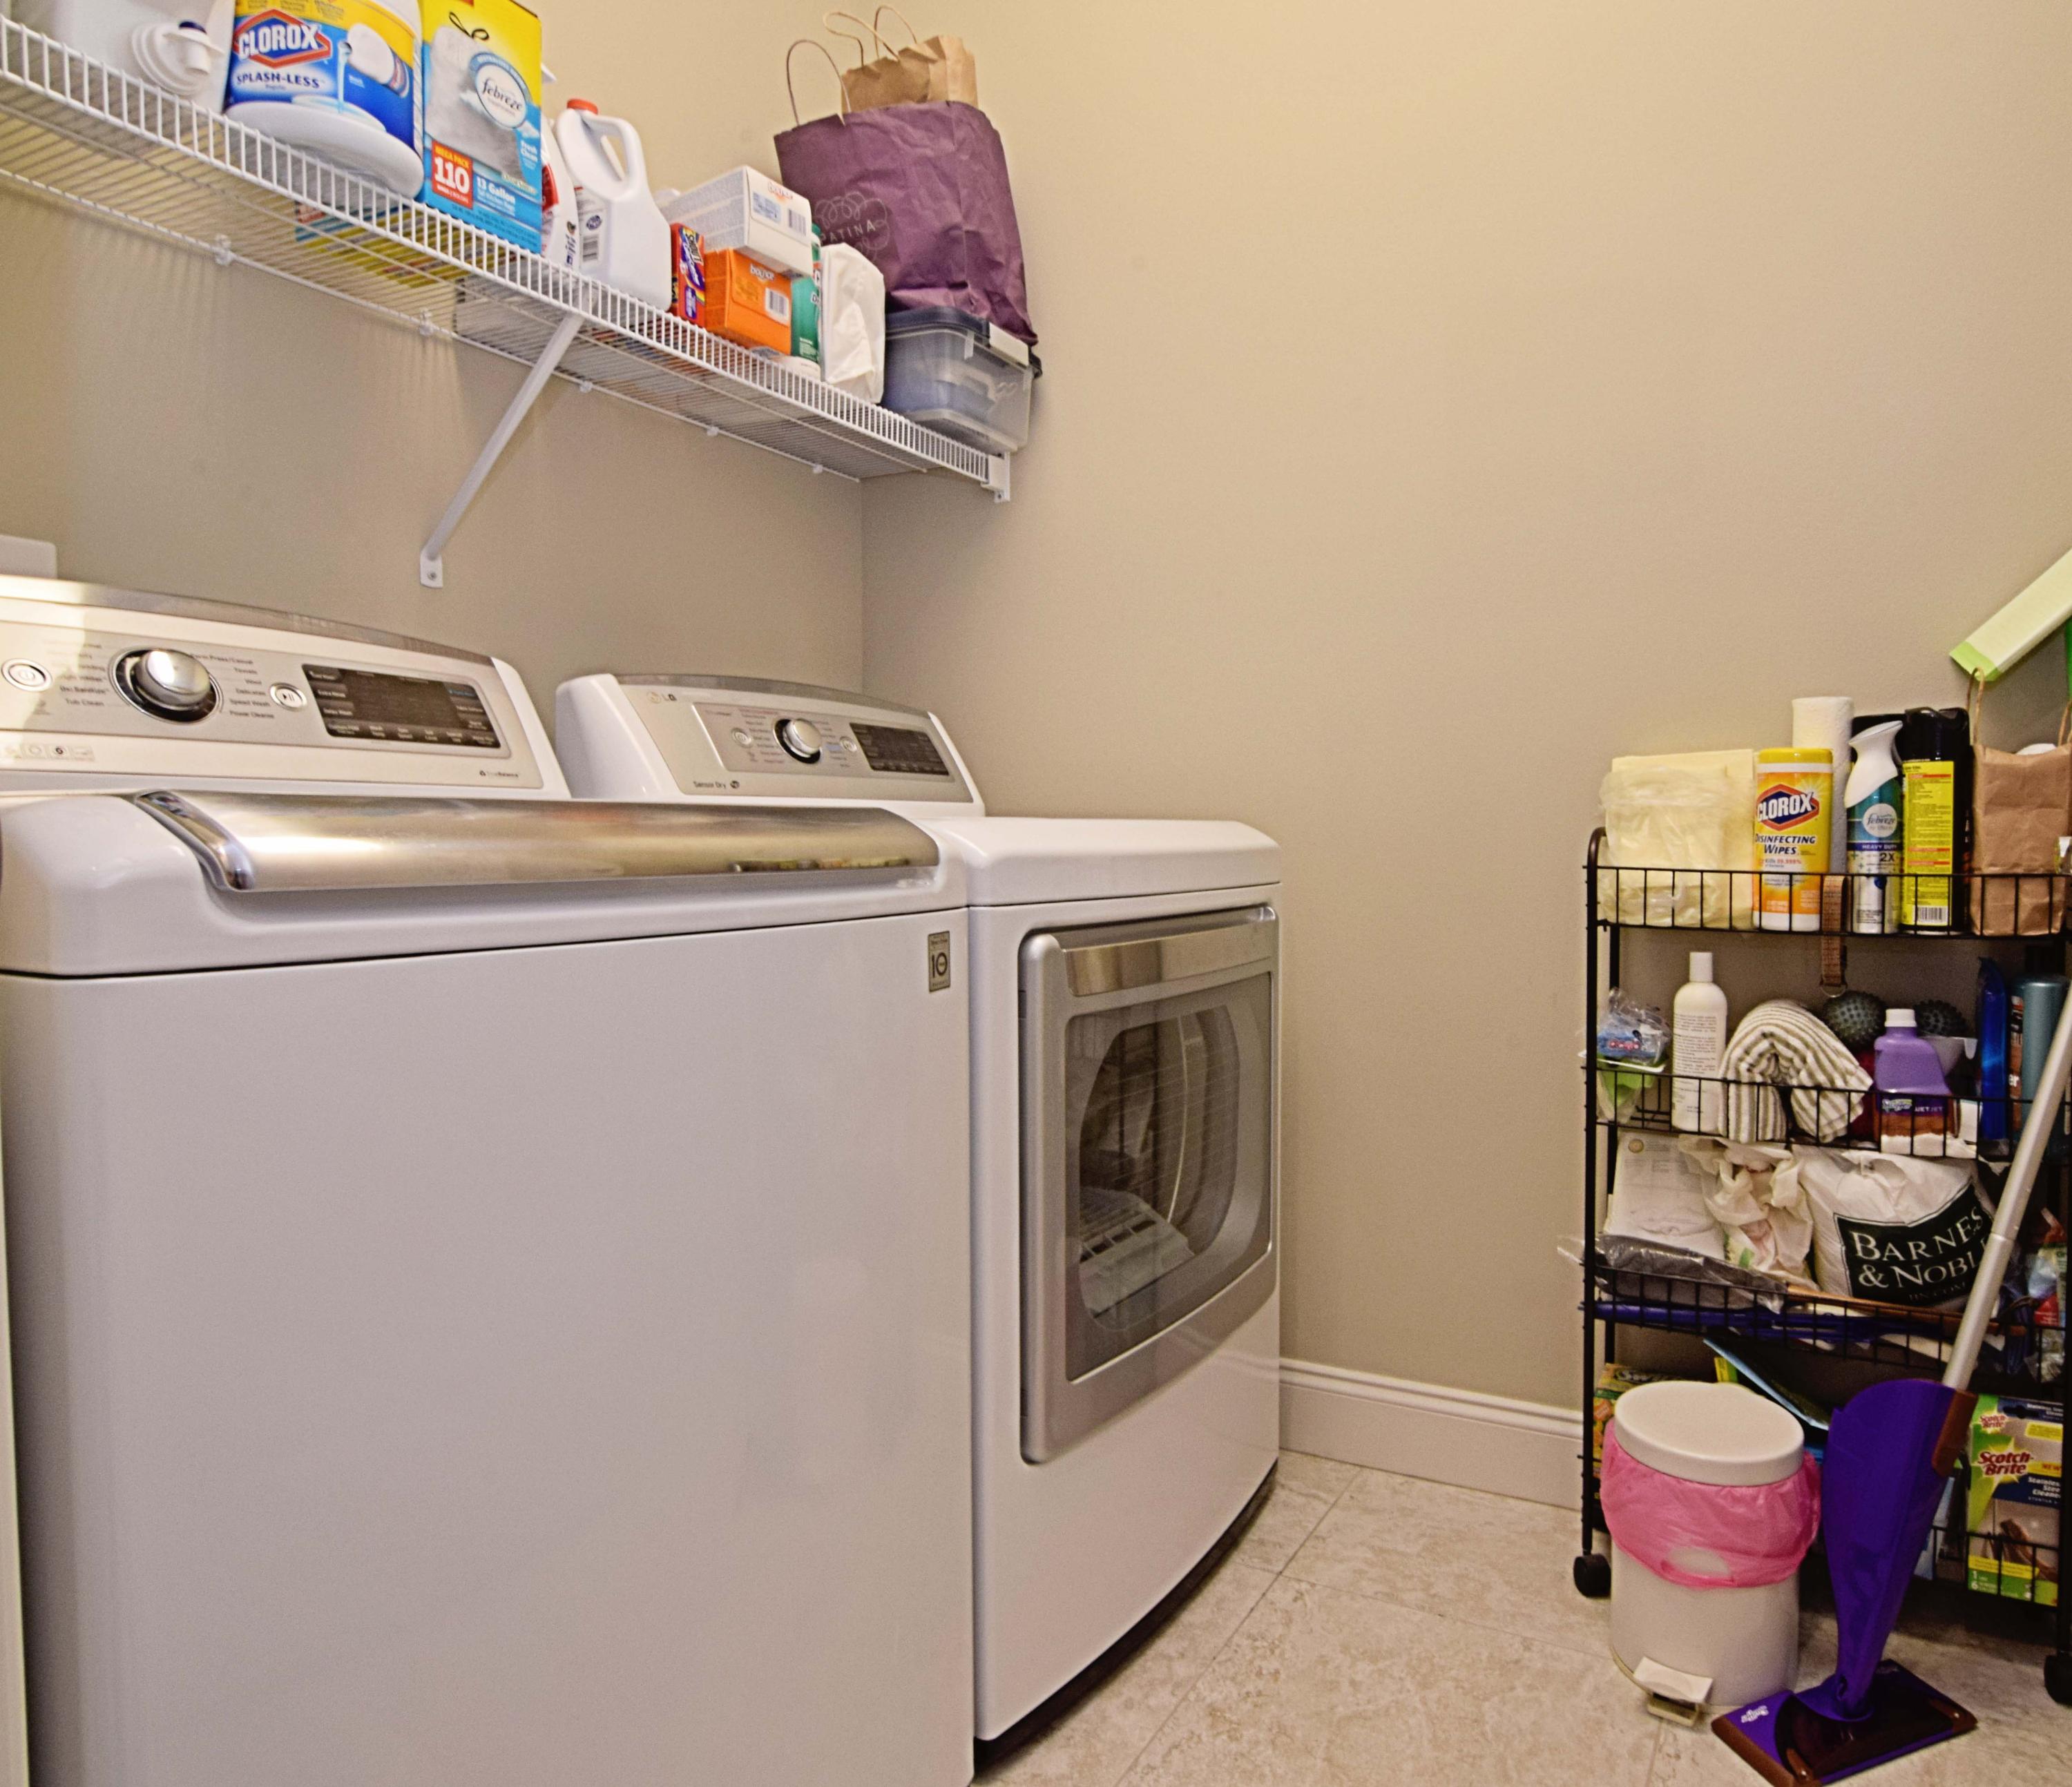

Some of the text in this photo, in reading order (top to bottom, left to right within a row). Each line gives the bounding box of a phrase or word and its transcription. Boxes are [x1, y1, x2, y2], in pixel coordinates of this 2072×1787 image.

[238, 24, 320, 60] CLOROX
[236, 72, 320, 88] SPLASH-LESS
[482, 78, 523, 111] febreze
[434, 156, 470, 194] 110
[477, 176, 487, 190] 13
[488, 182, 516, 205] Gallon
[750, 264, 774, 281] bounce
[662, 693, 678, 702] LG
[1757, 791, 1814, 822] CLOROX
[1764, 844, 1797, 855] WIPES
[1879, 852, 1895, 862] 2X
[931, 952, 948, 978] 10
[1850, 1206, 1984, 1262] BARNES
[1859, 1264, 1890, 1289] &
[1984, 1464, 2027, 1476] Brite
